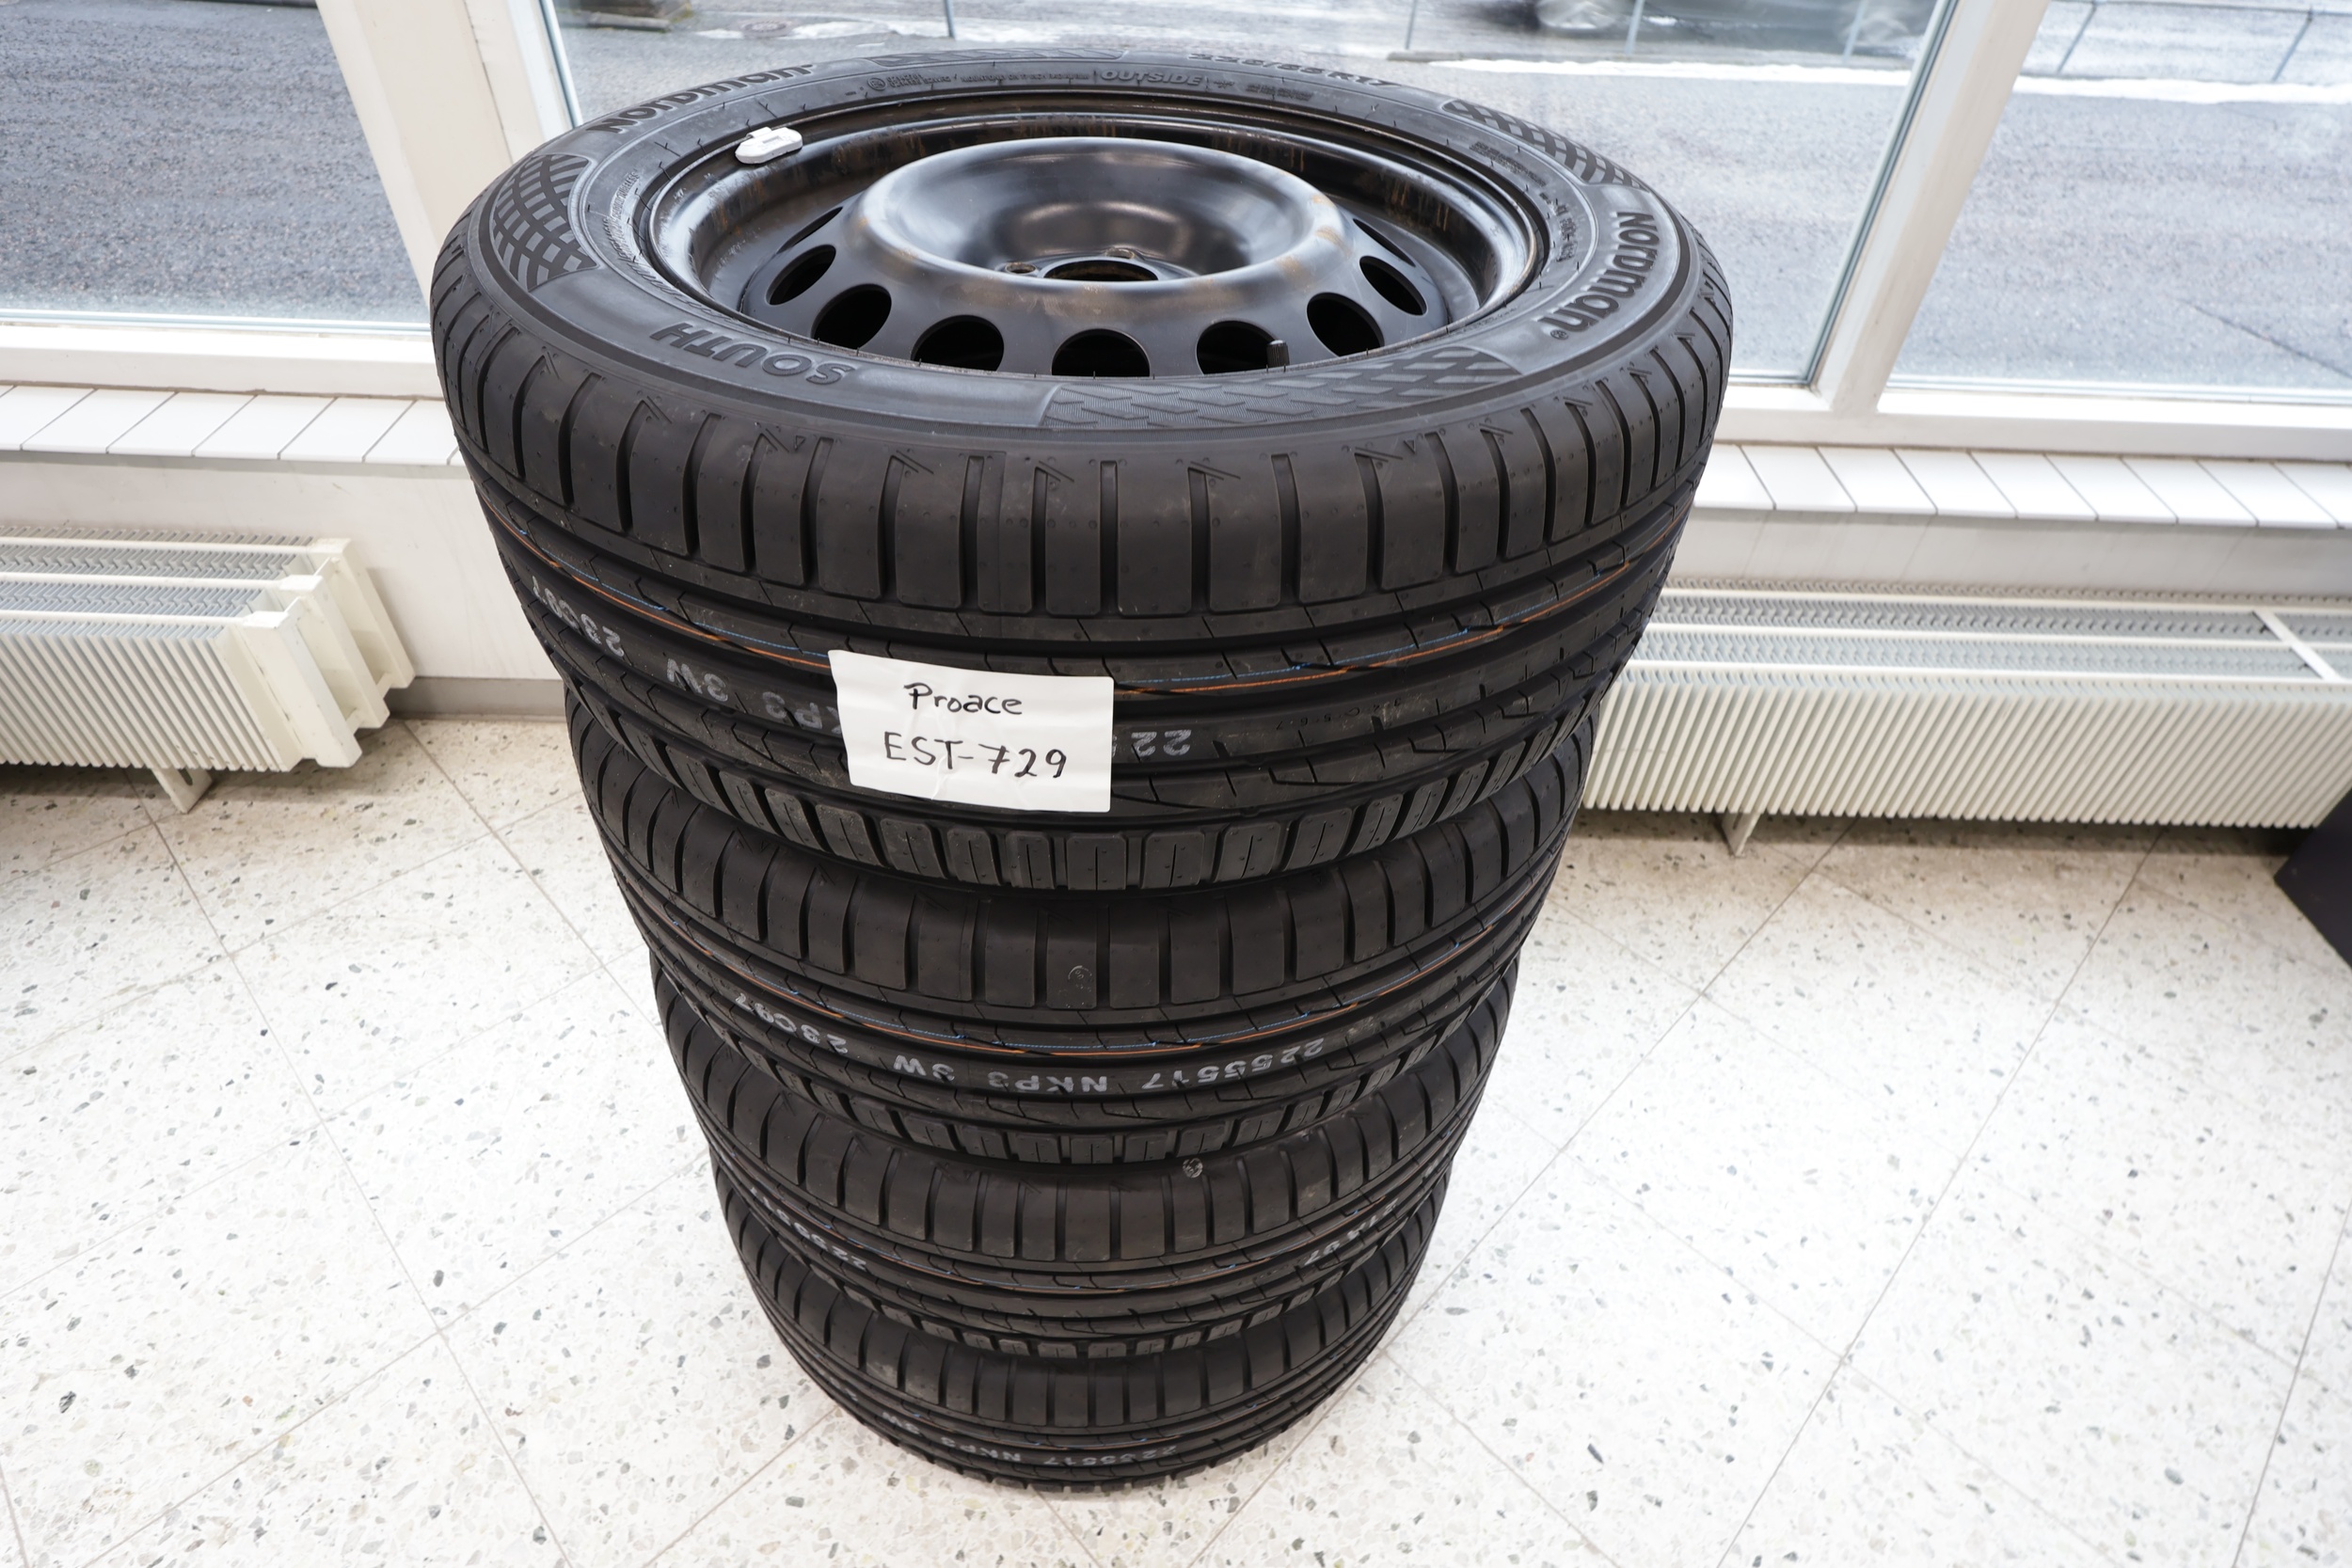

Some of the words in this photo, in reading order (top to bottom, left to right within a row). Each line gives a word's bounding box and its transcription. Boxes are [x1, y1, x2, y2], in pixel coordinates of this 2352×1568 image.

[1101, 68, 1205, 87] OUTSIDE
[650, 321, 854, 386] SOUTH
[667, 657, 727, 702] 3W
[904, 682, 1023, 715] Proace
[884, 731, 1067, 778] EST-729
[893, 1054, 954, 1083] 3W
[987, 1070, 1107, 1093] NKP3
[1139, 1037, 1324, 1090] 2255517
